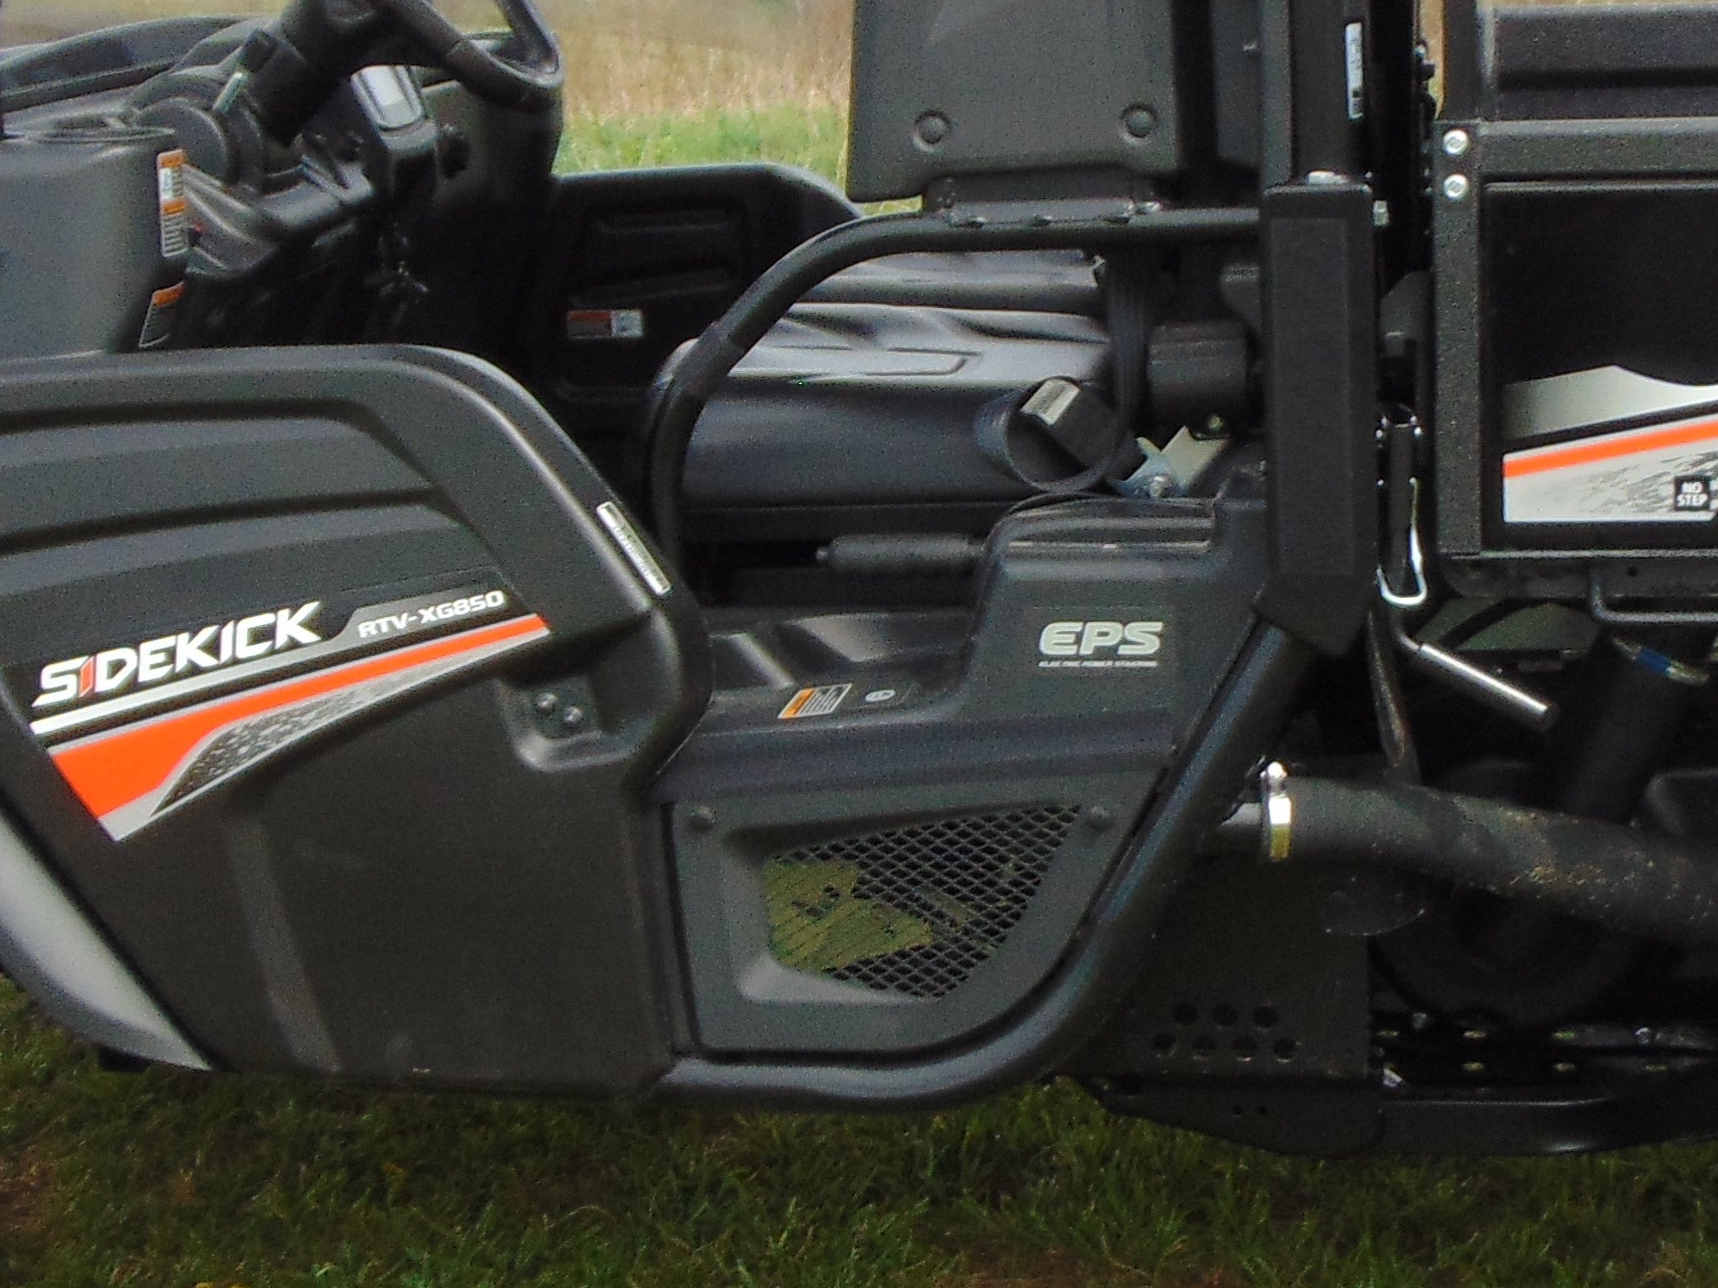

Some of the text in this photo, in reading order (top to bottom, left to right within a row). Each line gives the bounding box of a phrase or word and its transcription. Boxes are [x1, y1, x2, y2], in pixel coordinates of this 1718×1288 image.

[1681, 481, 1703, 493] NO
[1676, 493, 1709, 507] STEP
[31, 590, 506, 708] SIDEKICK RTV-XG850
[1039, 621, 1163, 655] EPS
